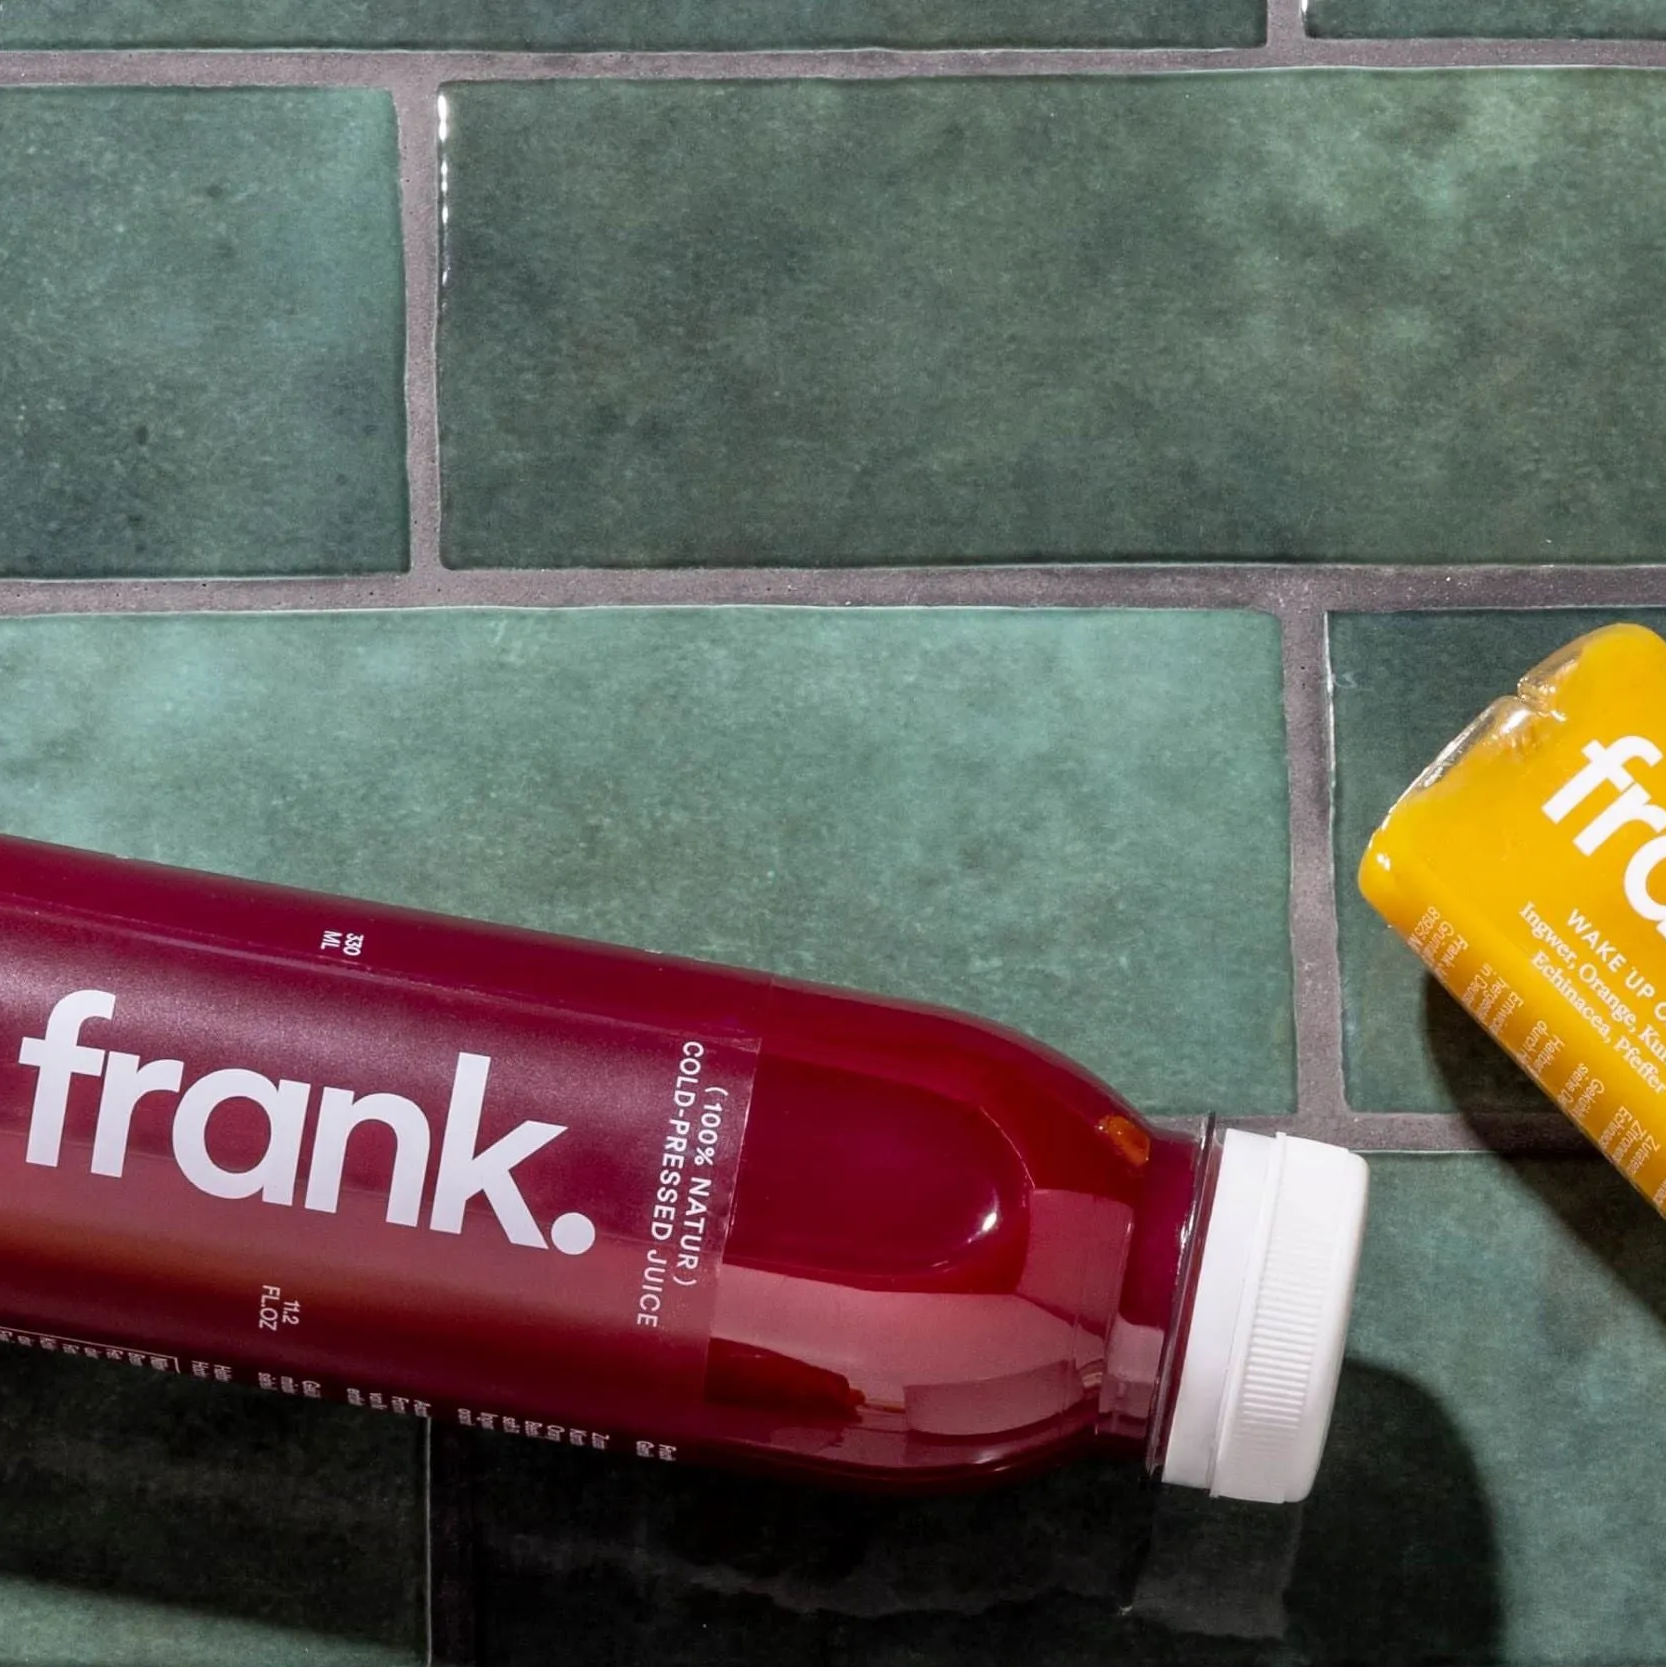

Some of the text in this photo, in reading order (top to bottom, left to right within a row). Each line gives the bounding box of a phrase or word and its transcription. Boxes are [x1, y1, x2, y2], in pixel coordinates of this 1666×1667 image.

[319, 929, 343, 953] ML
[341, 931, 365, 958] 330
[1519, 901, 1577, 970] Ingwer,
[1578, 962, 1636, 1033] Orange,
[1567, 908, 1625, 972] WAKE
[1625, 970, 1654, 997] UP
[1530, 950, 1666, 1092] Echinacea, Pfeffer
[20, 989, 597, 1254] frank.
[694, 1102, 722, 1165] 100%
[637, 1041, 703, 1326] COLD-PRESSED JUICE
[676, 1176, 711, 1269] NATUR
[258, 1284, 280, 1327] FL.OZ
[281, 1300, 300, 1324] 11.2
